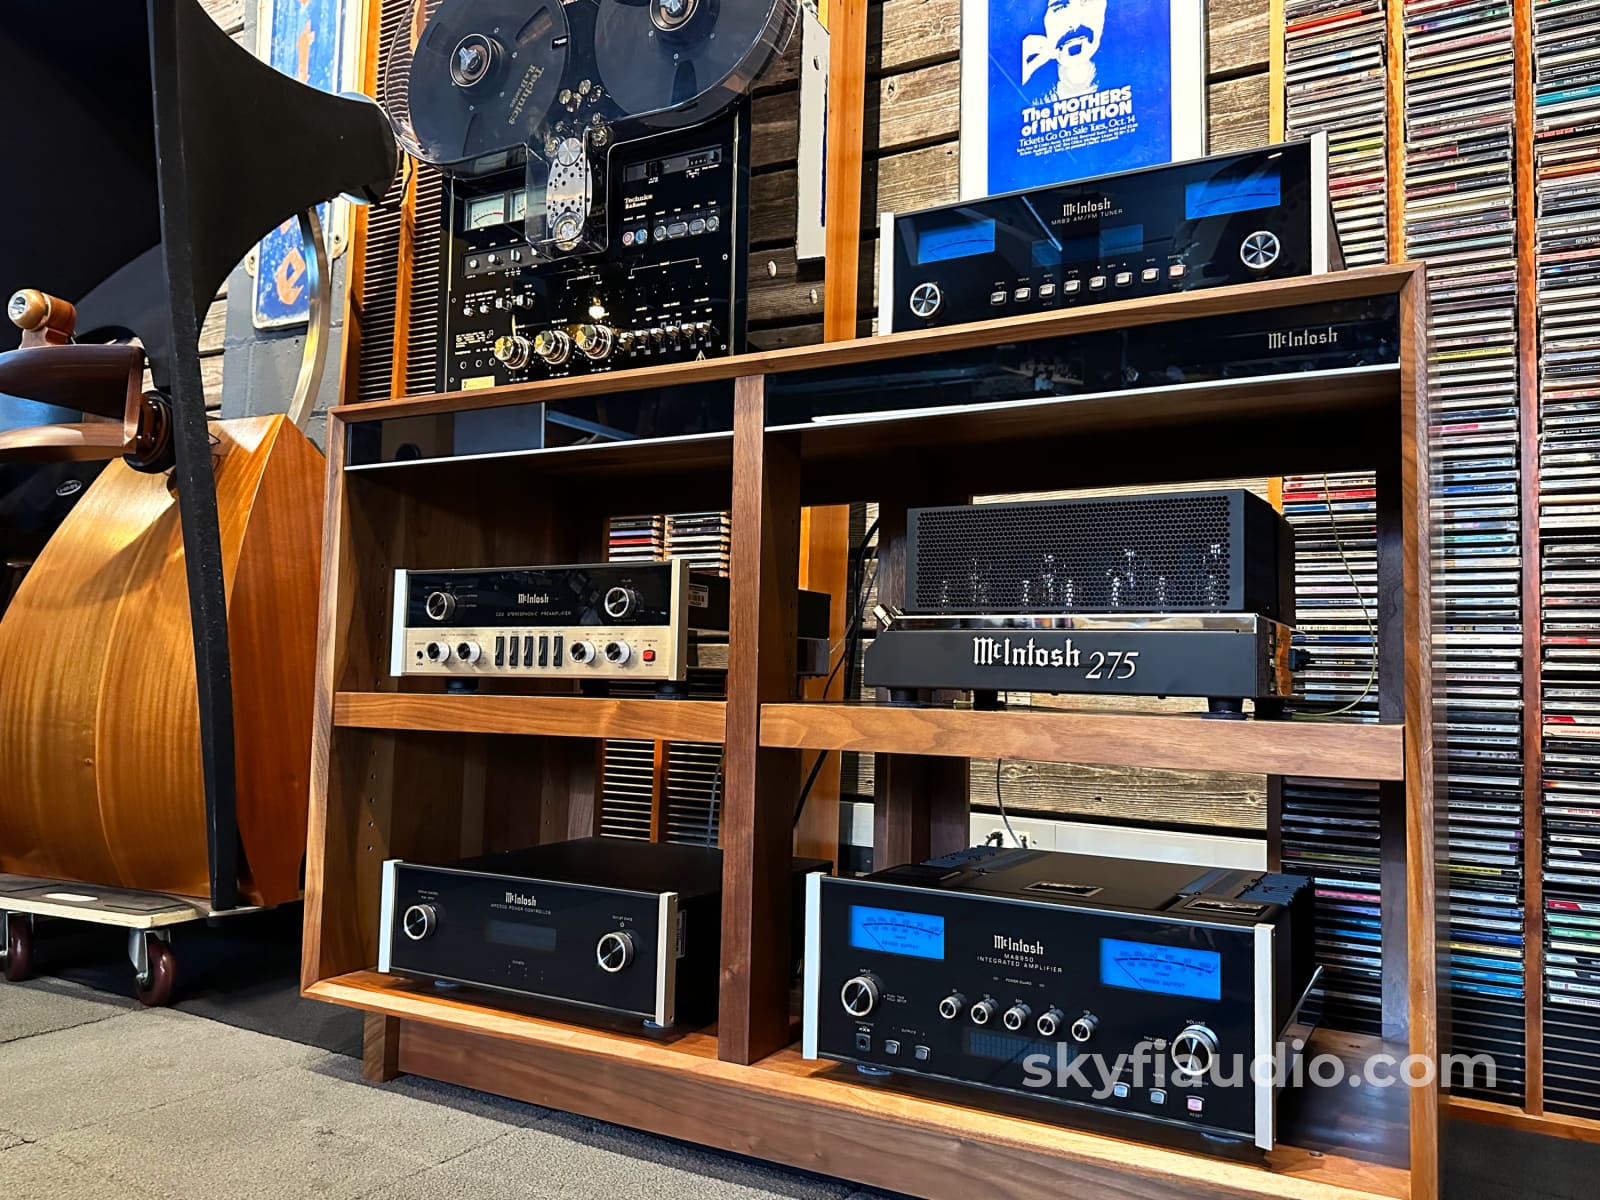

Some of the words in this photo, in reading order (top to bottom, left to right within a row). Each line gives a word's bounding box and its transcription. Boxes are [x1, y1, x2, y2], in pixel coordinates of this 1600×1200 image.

[508, 67, 544, 125] Technics
[1022, 107, 1051, 123] The
[1053, 85, 1132, 117] MOTHERS
[1021, 121, 1038, 137] of
[1040, 99, 1132, 133] INVENTION
[1019, 136, 1045, 147] Tickets
[1045, 132, 1058, 141] Go
[1058, 129, 1072, 138] On
[1072, 125, 1089, 136] Sale
[1126, 115, 1136, 124] 14
[1063, 197, 1111, 217] McIntosh
[1073, 213, 1098, 222] AM/FM
[1101, 208, 1123, 217] TUNER
[1268, 326, 1338, 349] McIntosh
[518, 593, 549, 604] McIntosh
[972, 636, 1081, 668] McIntosh
[1084, 651, 1140, 680] 275
[505, 891, 537, 907] McIntosh
[993, 934, 1045, 955] McIntosh
[977, 956, 1020, 967] INTEGRATED
[1023, 963, 1063, 973] AMPLIFIER
